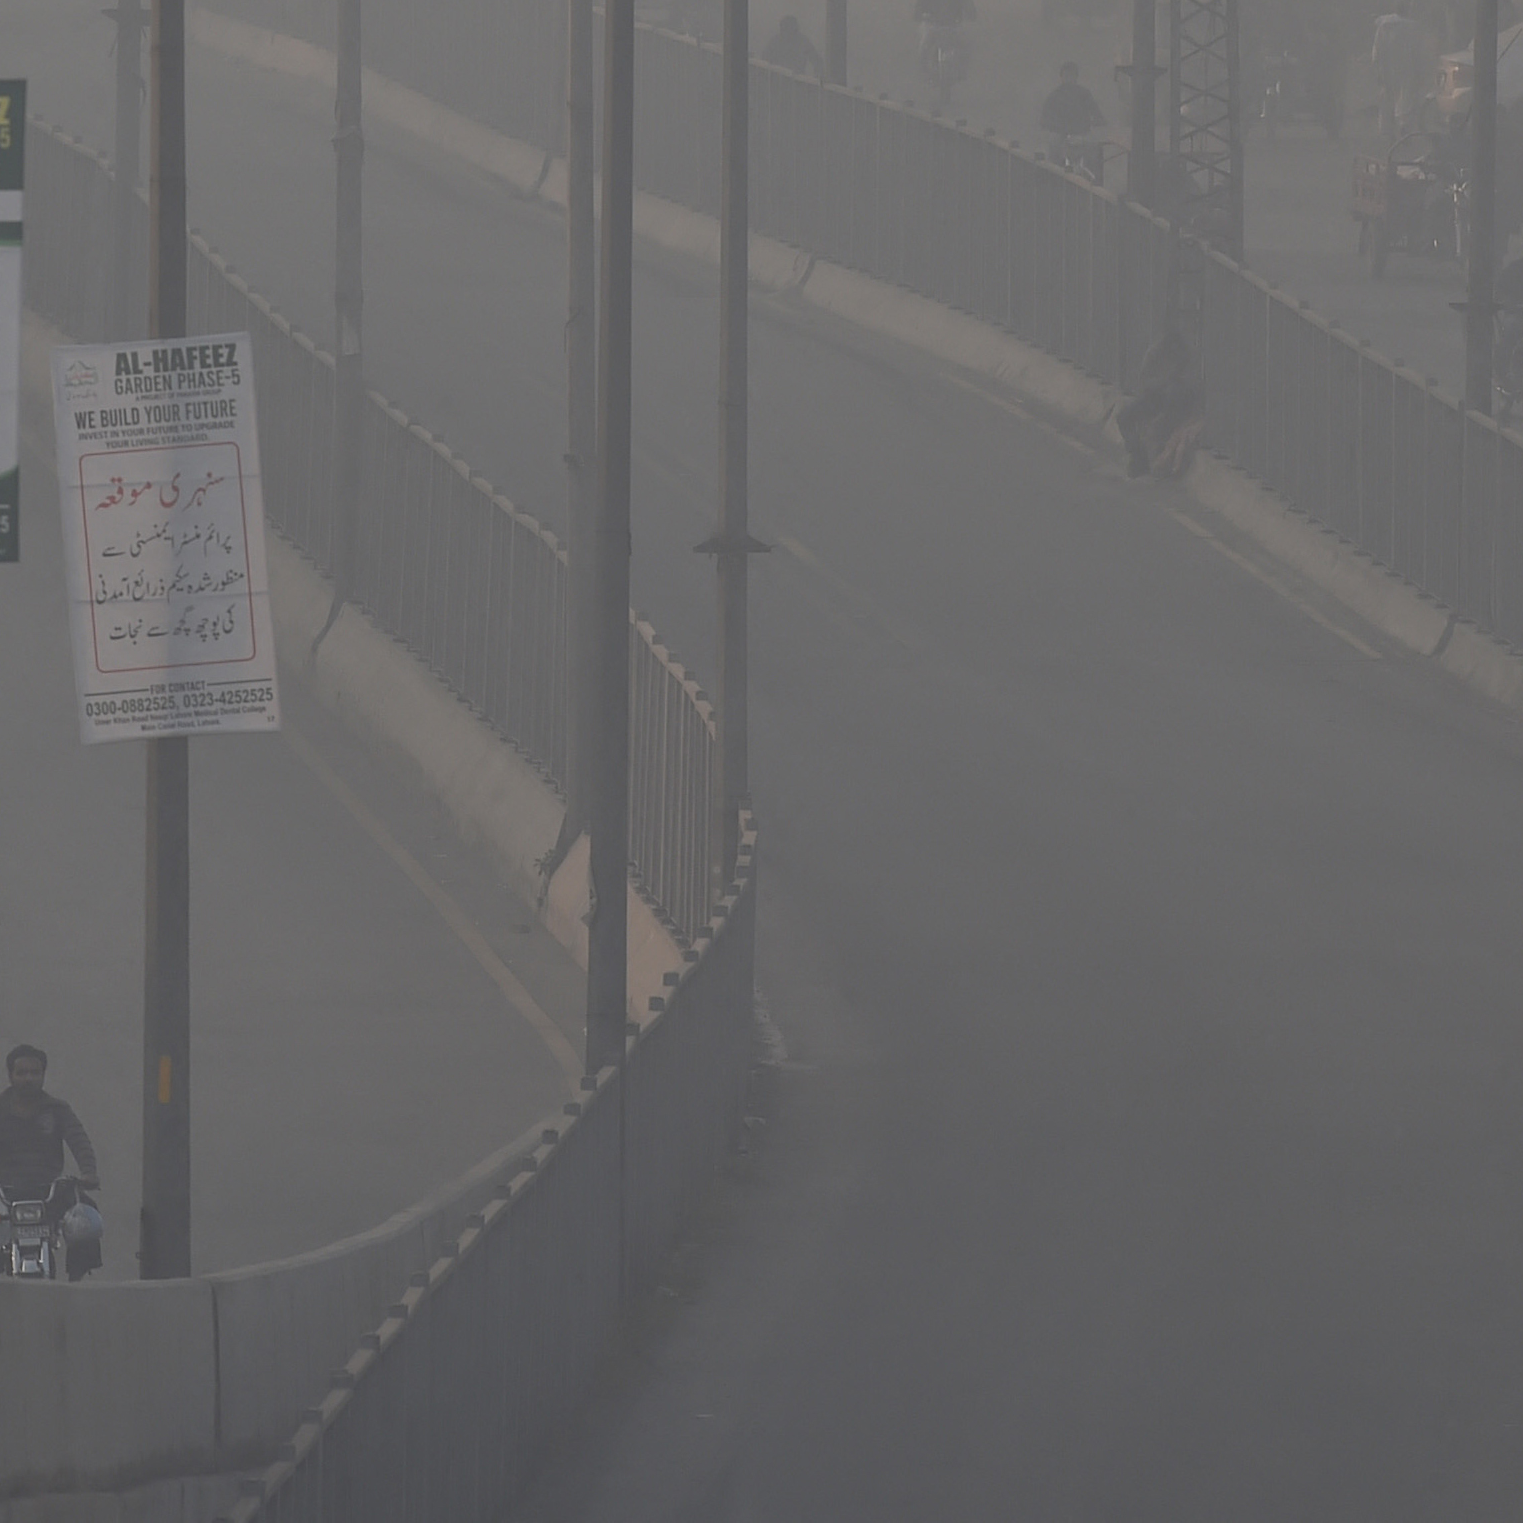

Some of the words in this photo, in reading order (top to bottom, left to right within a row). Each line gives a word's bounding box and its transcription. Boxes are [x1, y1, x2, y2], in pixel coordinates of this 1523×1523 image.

[115, 343, 238, 376] AL-HAFEEZ
[114, 374, 172, 395] GARDEN
[178, 368, 241, 390] PHASE-5
[74, 410, 95, 429] WE
[100, 407, 140, 428] BUILD
[144, 404, 181, 425] YOUR
[185, 399, 238, 421] FUTURE
[78, 430, 109, 441] INVEST
[110, 429, 120, 438] IN
[121, 427, 145, 437] YOUR
[146, 425, 179, 436] FUTURE
[194, 420, 236, 431] UPGRADE
[95, 476, 152, 511] موقعہ
[159, 471, 225, 512] سنہری
[102, 547, 126, 558] سے
[96, 573, 130, 605] آمدنی
[132, 569, 165, 602] ذرائع
[212, 569, 245, 592] منظور
[109, 618, 143, 645] نجات
[147, 626, 169, 637] سے
[222, 603, 236, 634] کی
[86, 695, 179, 717] 0300-0882525,
[183, 687, 274, 709] 0323-4252525
[150, 684, 166, 695] FOR
[168, 680, 205, 694] CONTACT
